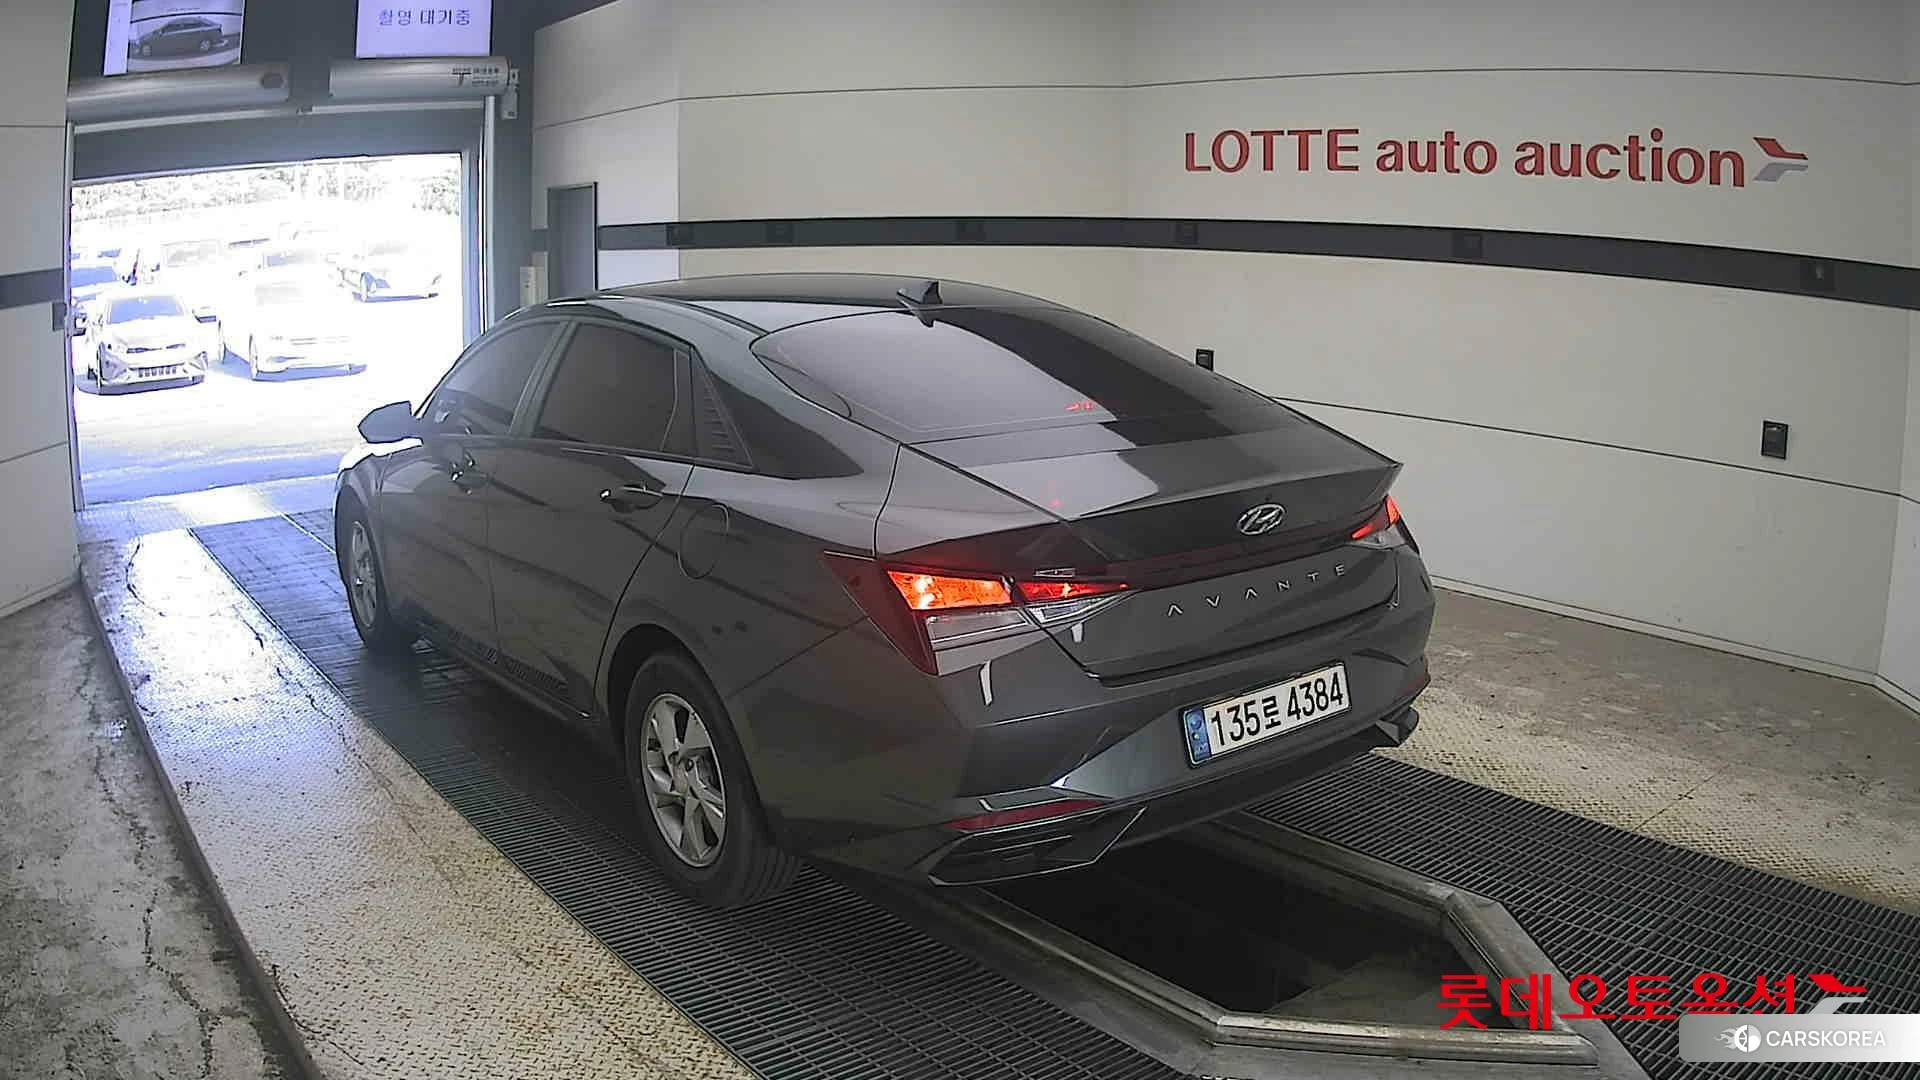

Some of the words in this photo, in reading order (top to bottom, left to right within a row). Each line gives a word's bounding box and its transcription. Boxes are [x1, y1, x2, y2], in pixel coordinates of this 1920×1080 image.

[420, 9, 470, 26] 대기중
[1185, 129, 1359, 173] LOTTE
[1376, 131, 1497, 175] auto
[1514, 128, 1744, 187] auction
[1167, 564, 1345, 616] AVANTE
[1211, 695, 1281, 746] 135로
[1287, 671, 1344, 720] 4384
